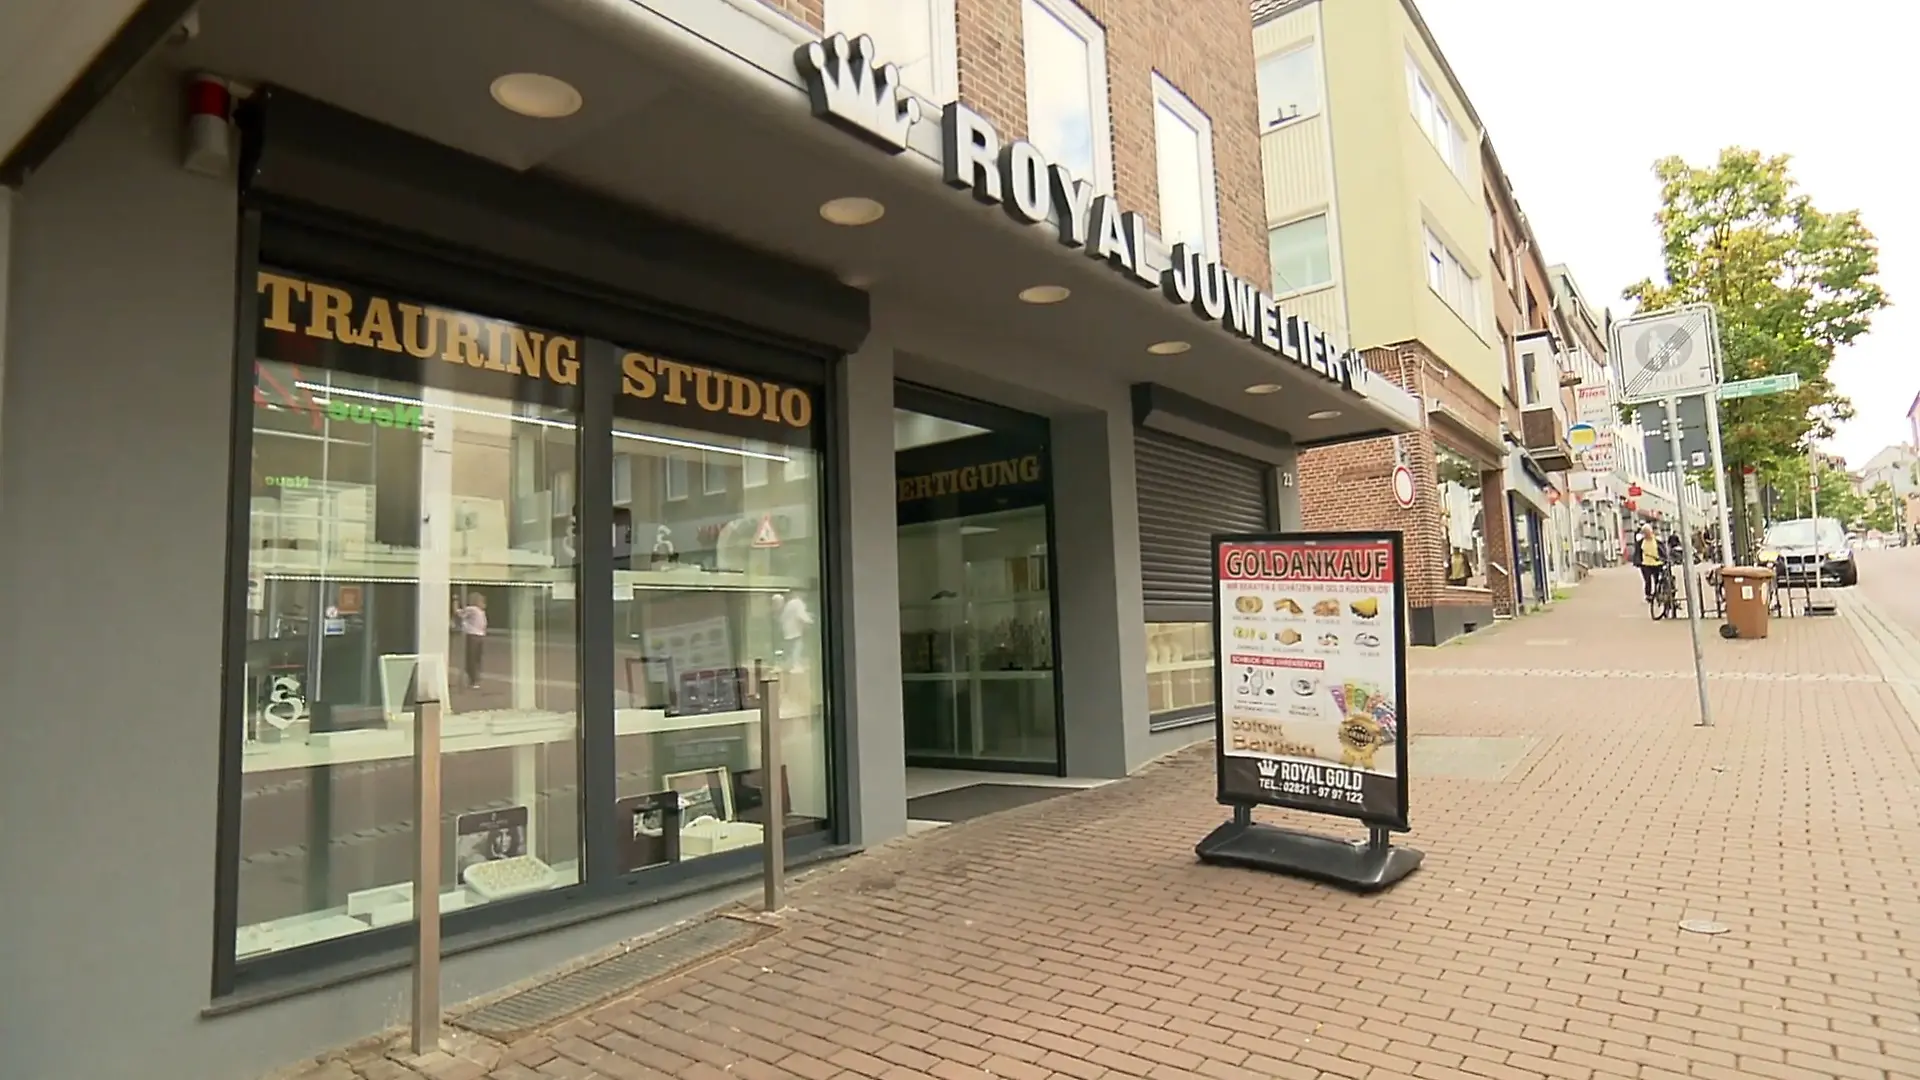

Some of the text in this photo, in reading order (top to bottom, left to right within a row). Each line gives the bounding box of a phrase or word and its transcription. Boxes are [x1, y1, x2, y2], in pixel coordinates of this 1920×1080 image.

[944, 101, 1344, 383] ROYAL JUWELIER
[257, 272, 811, 427] TRAURING STUDIO
[1226, 550, 1388, 580] GOLDANKAUF
[1281, 763, 1362, 791] ROYAL GOLD
[1283, 781, 1310, 795] 02821
[1319, 788, 1331, 798] 97
[1332, 790, 1343, 800] 97
[1346, 792, 1363, 804] 122
